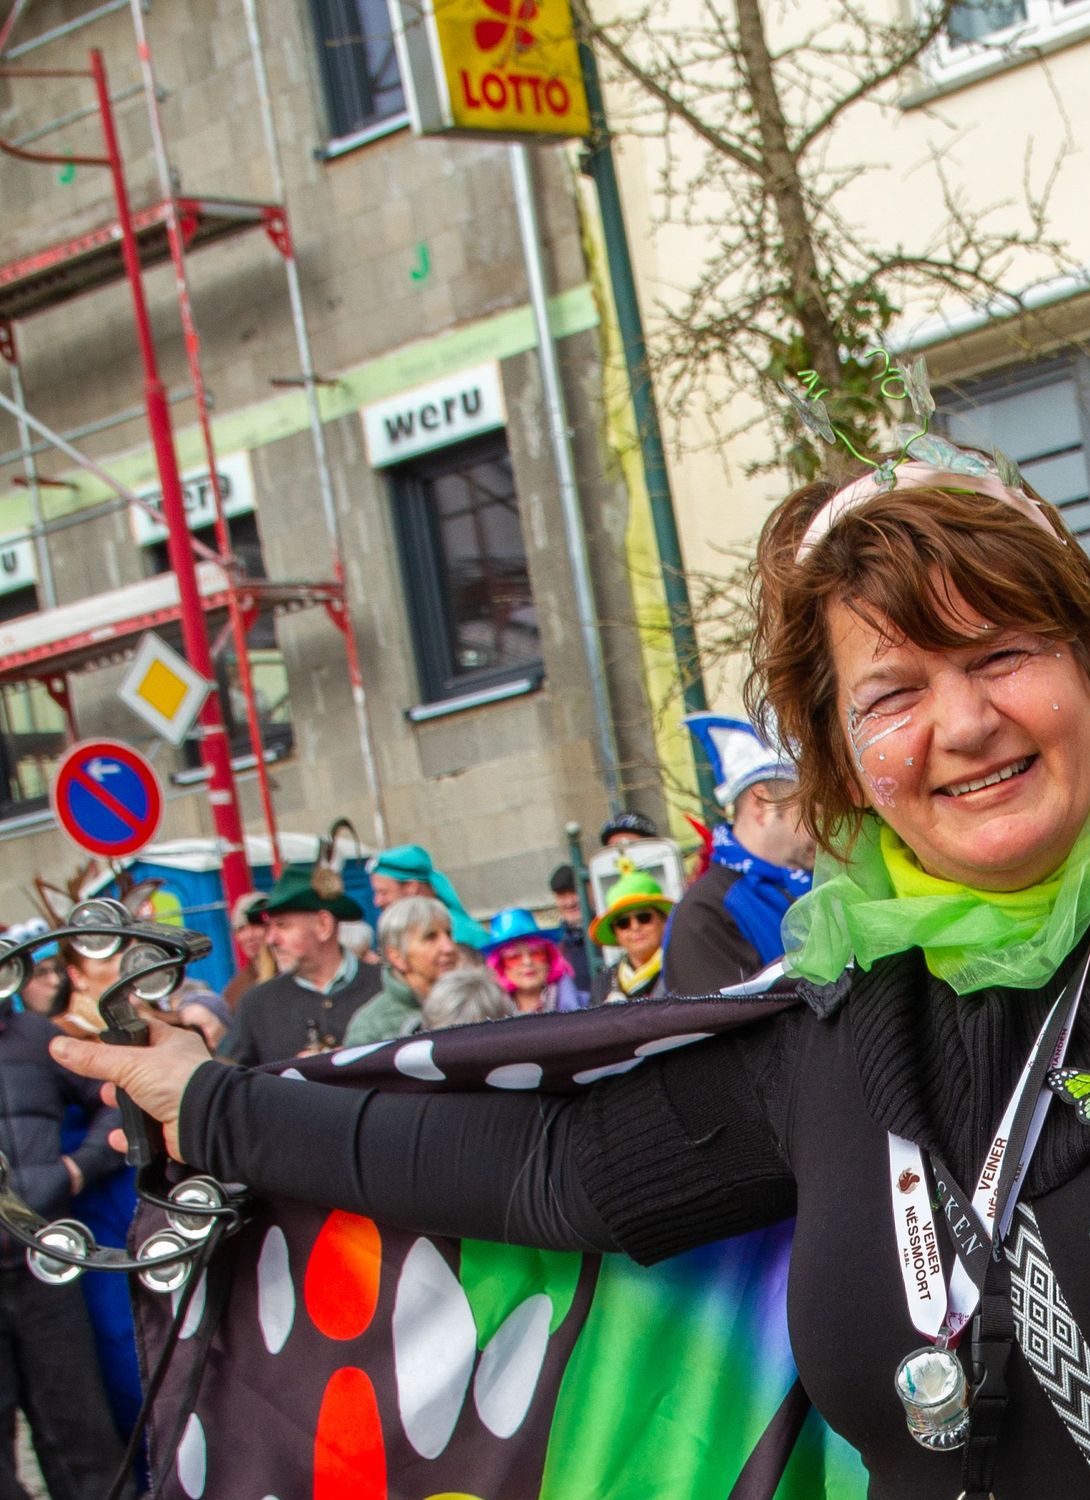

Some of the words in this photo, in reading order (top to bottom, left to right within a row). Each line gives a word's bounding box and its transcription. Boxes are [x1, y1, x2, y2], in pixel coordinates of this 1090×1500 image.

[460, 69, 571, 118] LOTTO
[384, 386, 482, 444] weru
[978, 1137, 1008, 1191] VEINER
[932, 1166, 984, 1256] CKEN
[905, 1205, 932, 1301] NËSSMOORT
[922, 1220, 941, 1276] VEINER
